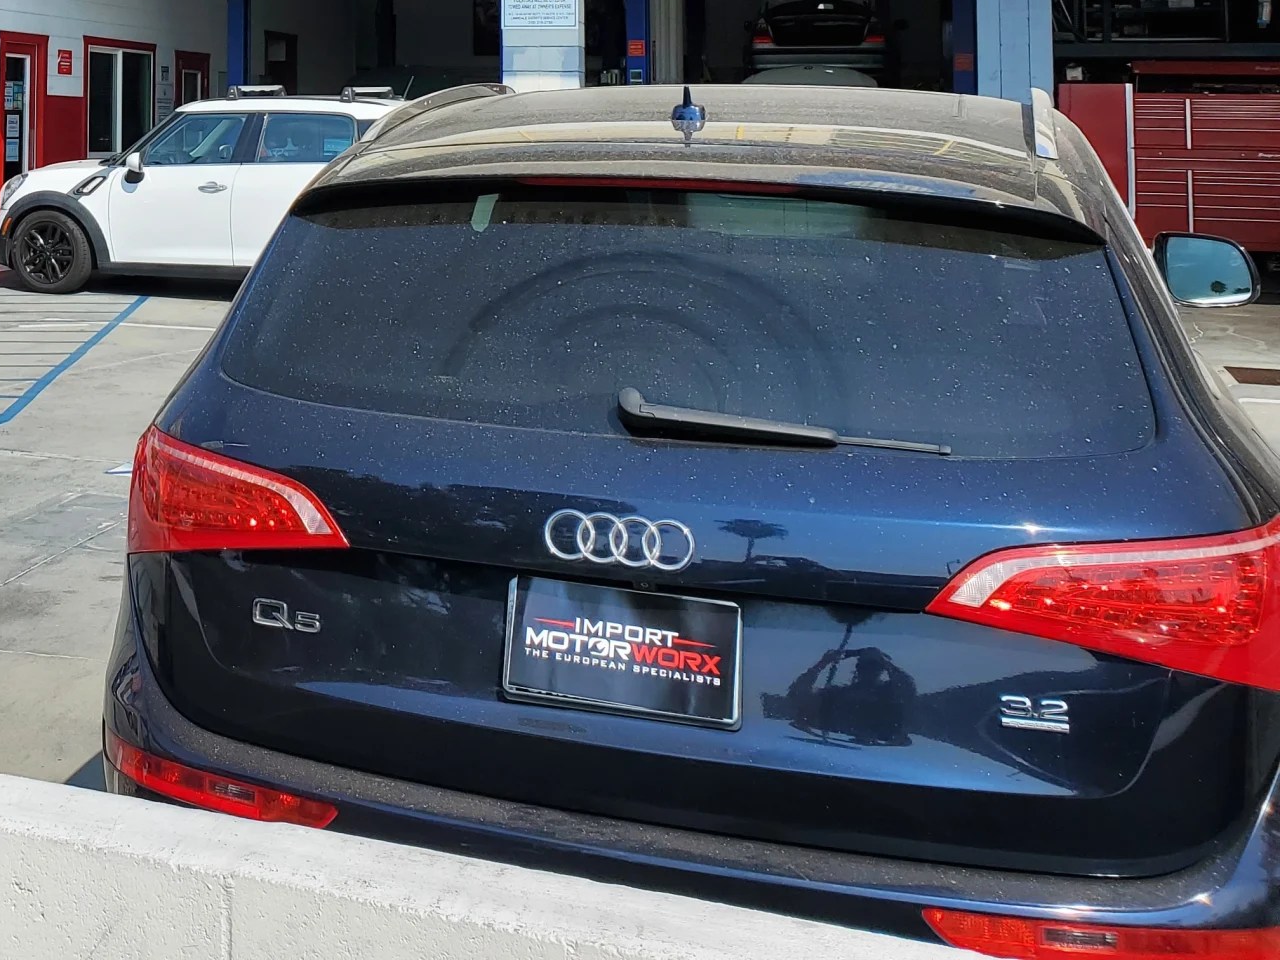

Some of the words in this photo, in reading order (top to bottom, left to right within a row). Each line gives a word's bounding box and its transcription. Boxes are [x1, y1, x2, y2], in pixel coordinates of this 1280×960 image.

[252, 596, 321, 633] Q5
[573, 616, 679, 649] IMPORT
[524, 646, 549, 659] THE
[555, 651, 626, 671] EUROPEAN
[632, 664, 721, 687] SPECIALISTS
[525, 626, 720, 676] MOTORWORX
[1000, 695, 1069, 722] 3.2
